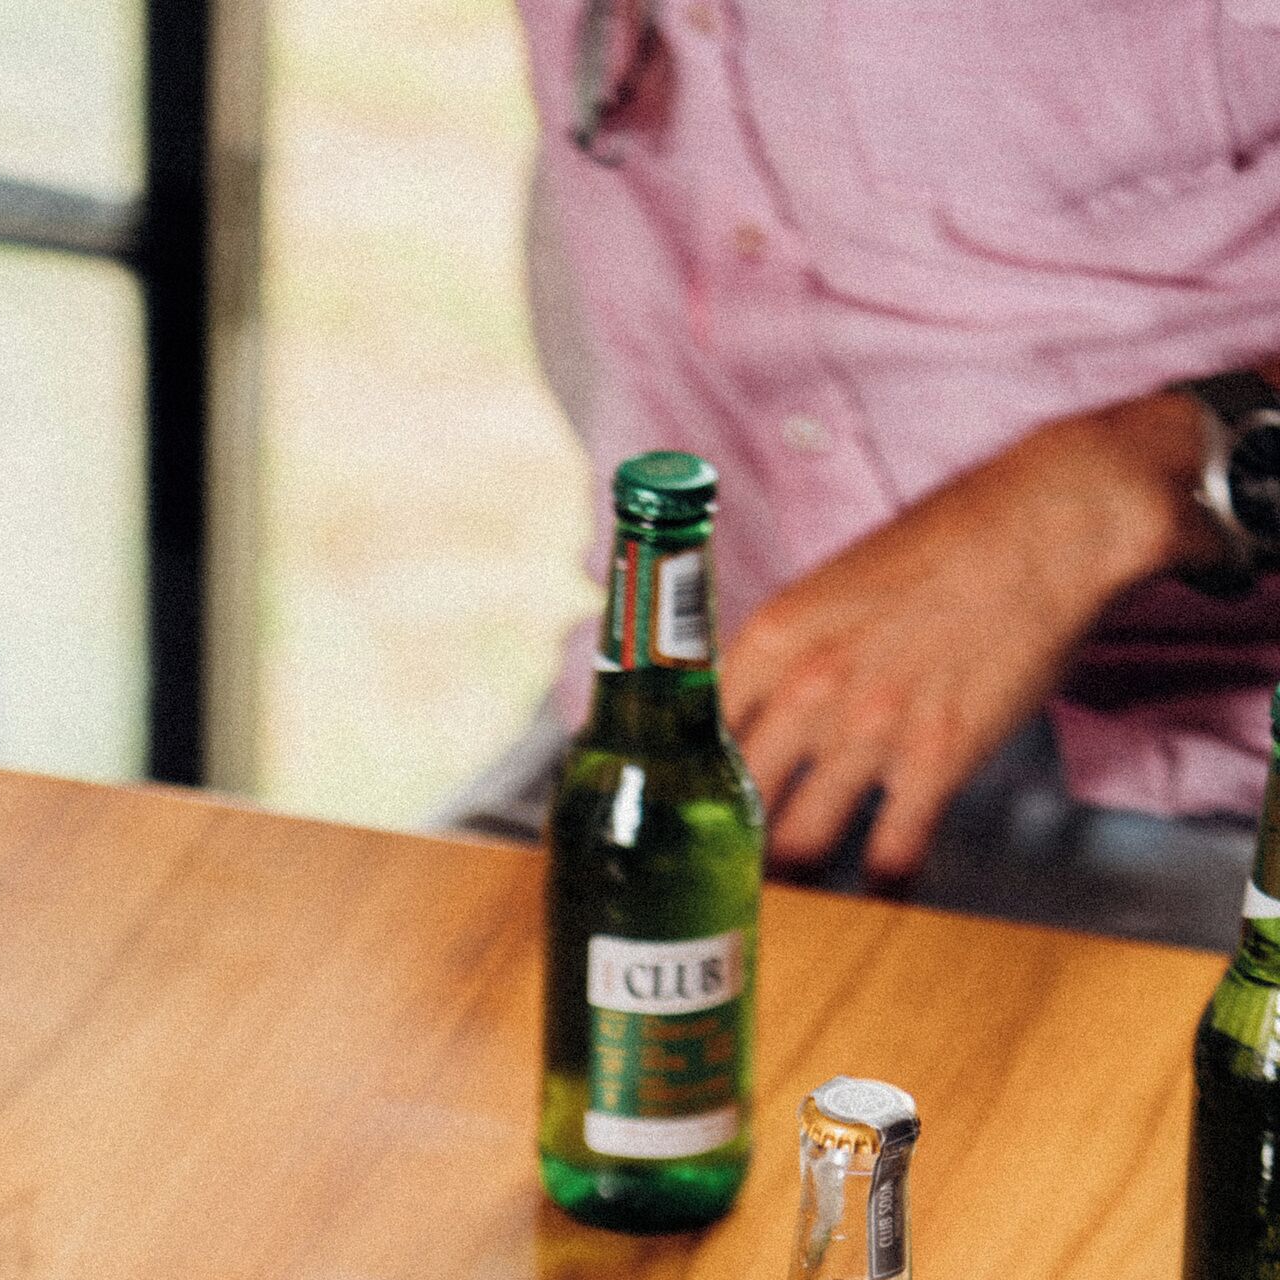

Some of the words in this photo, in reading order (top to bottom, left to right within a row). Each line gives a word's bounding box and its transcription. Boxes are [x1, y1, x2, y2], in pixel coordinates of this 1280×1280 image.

[624, 956, 725, 1000] CLUB
[878, 1179, 895, 1216] SODA
[878, 1217, 894, 1249] CLUB
